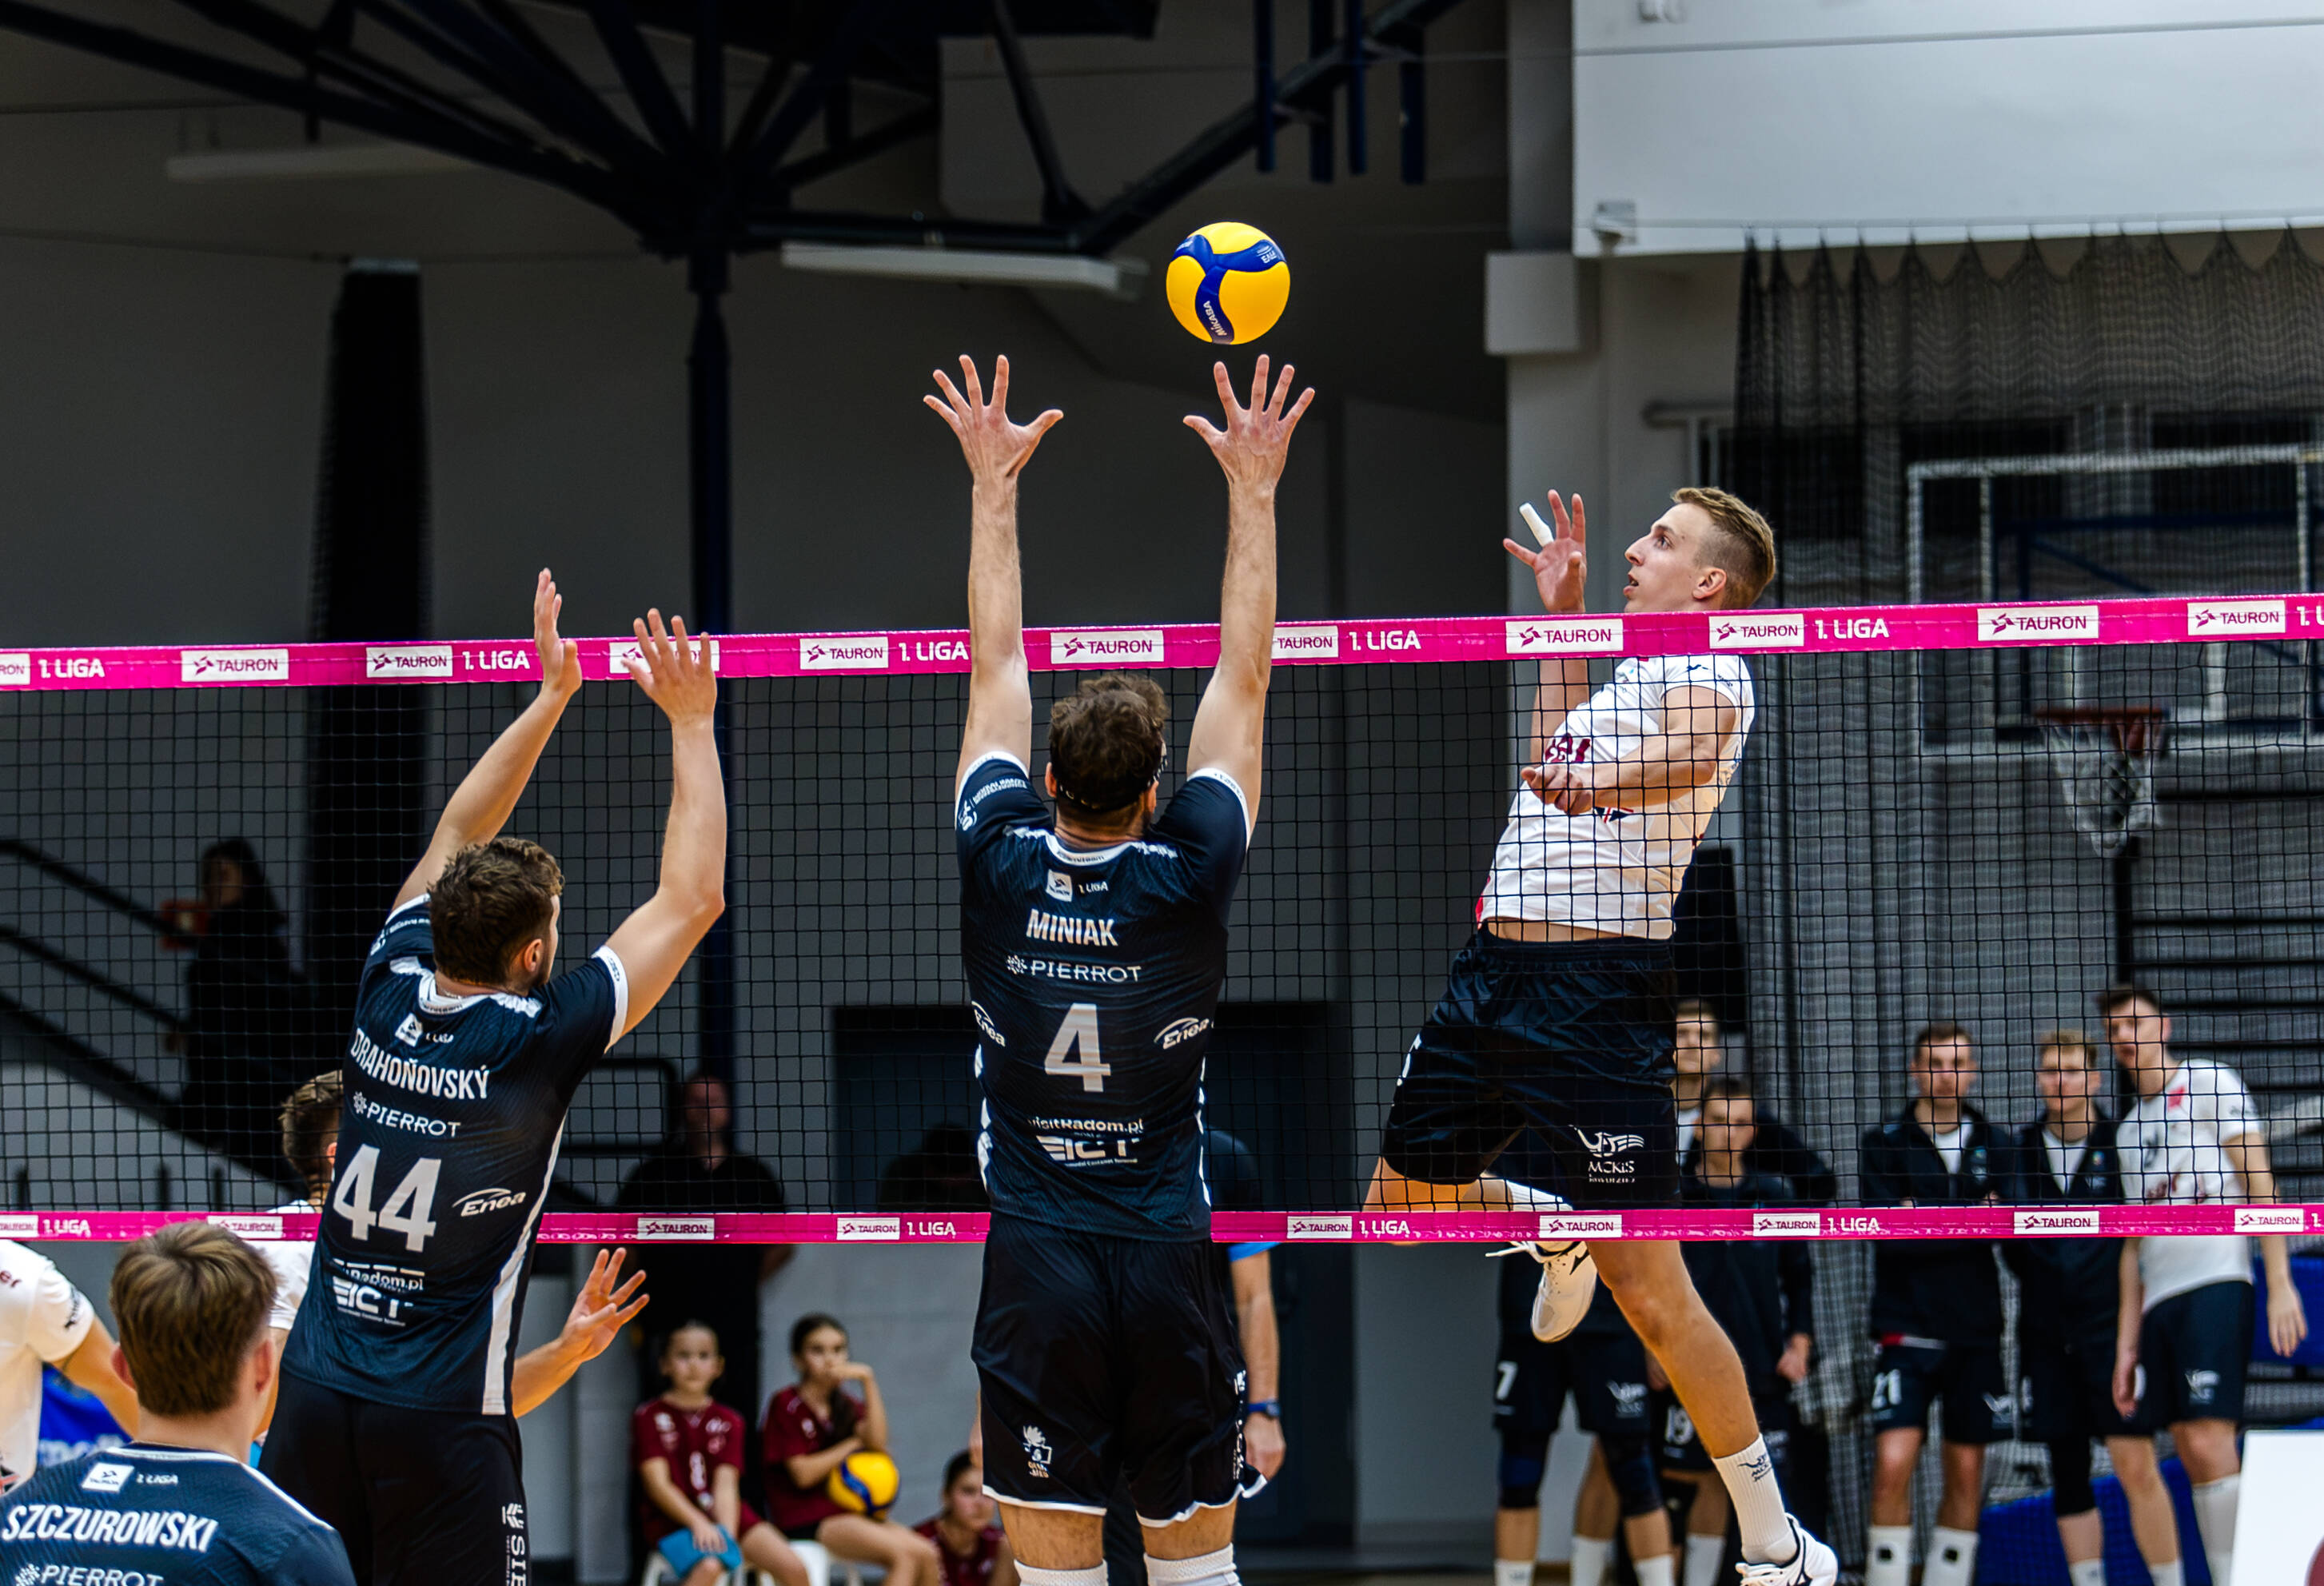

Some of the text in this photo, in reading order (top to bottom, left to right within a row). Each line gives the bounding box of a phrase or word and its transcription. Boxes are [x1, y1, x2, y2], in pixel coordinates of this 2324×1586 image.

[1742, 625, 1799, 639] TAURON
[1833, 618, 1890, 639] LIGA
[2015, 616, 2087, 632] TAURON
[2219, 612, 2280, 625] TAURON
[1278, 636, 1333, 649] TAURON
[1366, 630, 1421, 651] LIGA
[1543, 628, 1612, 644] TAURON
[829, 647, 883, 661] TAURON
[916, 640, 969, 661] LIGA
[1087, 640, 1152, 655] TAURON
[0, 664, 24, 675] RON
[54, 658, 106, 679] LIGA
[216, 660, 278, 673] TAURON
[395, 656, 448, 669] TAURON
[479, 650, 531, 671] LIGA
[1026, 908, 1118, 946] MINIAK
[1030, 959, 1142, 982] PIERROT
[1044, 1002, 1111, 1093] 4
[350, 1026, 490, 1100] DRAHOŇOVSKÝ
[367, 1102, 461, 1138] PIERROT
[333, 1143, 442, 1253] 44
[54, 1219, 92, 1238] LIGA
[231, 1222, 276, 1233] TAURON
[662, 1224, 708, 1234] TAURON
[857, 1225, 897, 1234] TAURON
[919, 1221, 957, 1237] LIGA
[1309, 1223, 1349, 1232] TAURON
[1371, 1220, 1410, 1236] LIGA
[1565, 1221, 1613, 1231] TAURON
[1774, 1220, 1816, 1229] TAURON
[1840, 1217, 1880, 1232] LIGA
[2041, 1217, 2091, 1229] TAURON
[2257, 1216, 2299, 1225] TAURON
[1496, 1361, 1518, 1401] 7
[1, 1504, 219, 1553] SZCZUROWSKI
[40, 1564, 164, 1586] PIERROT
